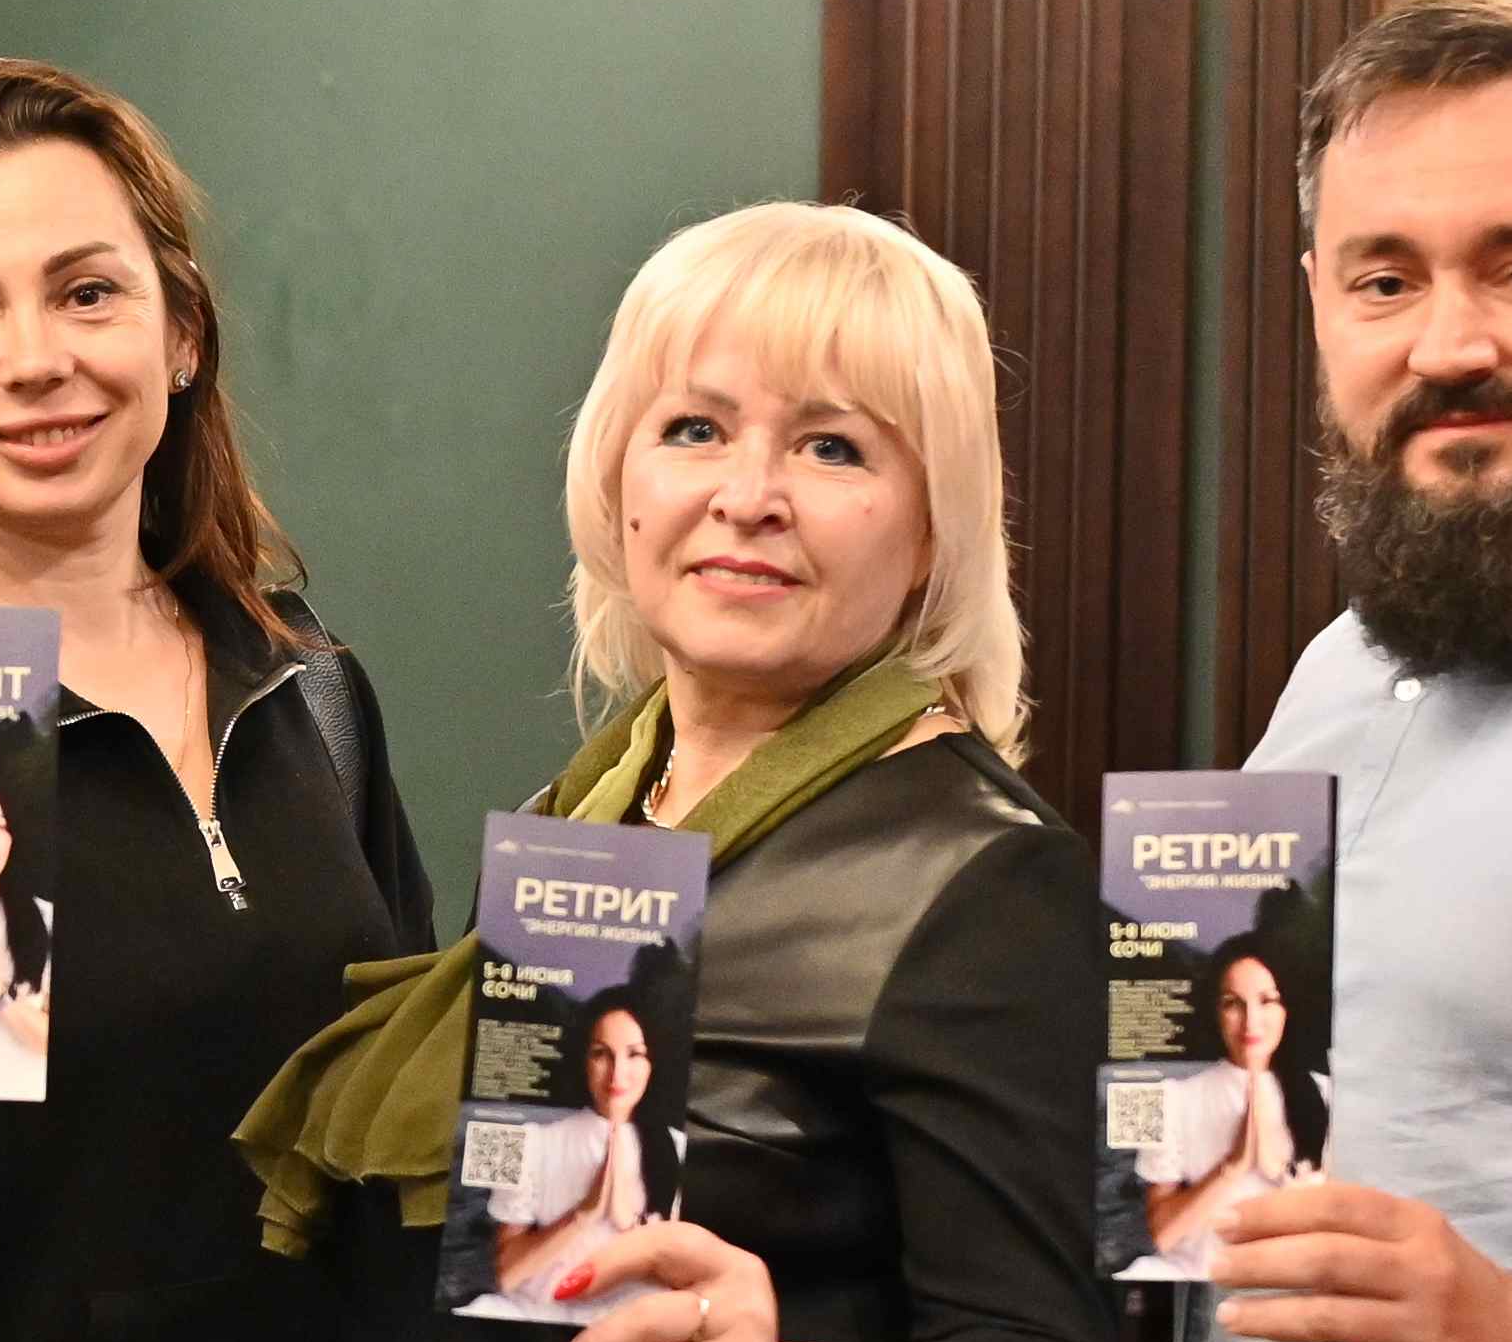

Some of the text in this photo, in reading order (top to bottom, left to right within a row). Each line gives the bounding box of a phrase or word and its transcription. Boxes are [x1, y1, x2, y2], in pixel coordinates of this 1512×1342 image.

[1132, 832, 1301, 870] РЕТРИТ
[514, 877, 679, 927] РЕТРИТ
[1109, 940, 1163, 958] СОЧИ
[516, 964, 575, 987] ИЮНЯ
[482, 979, 537, 1002] СОЧИ
